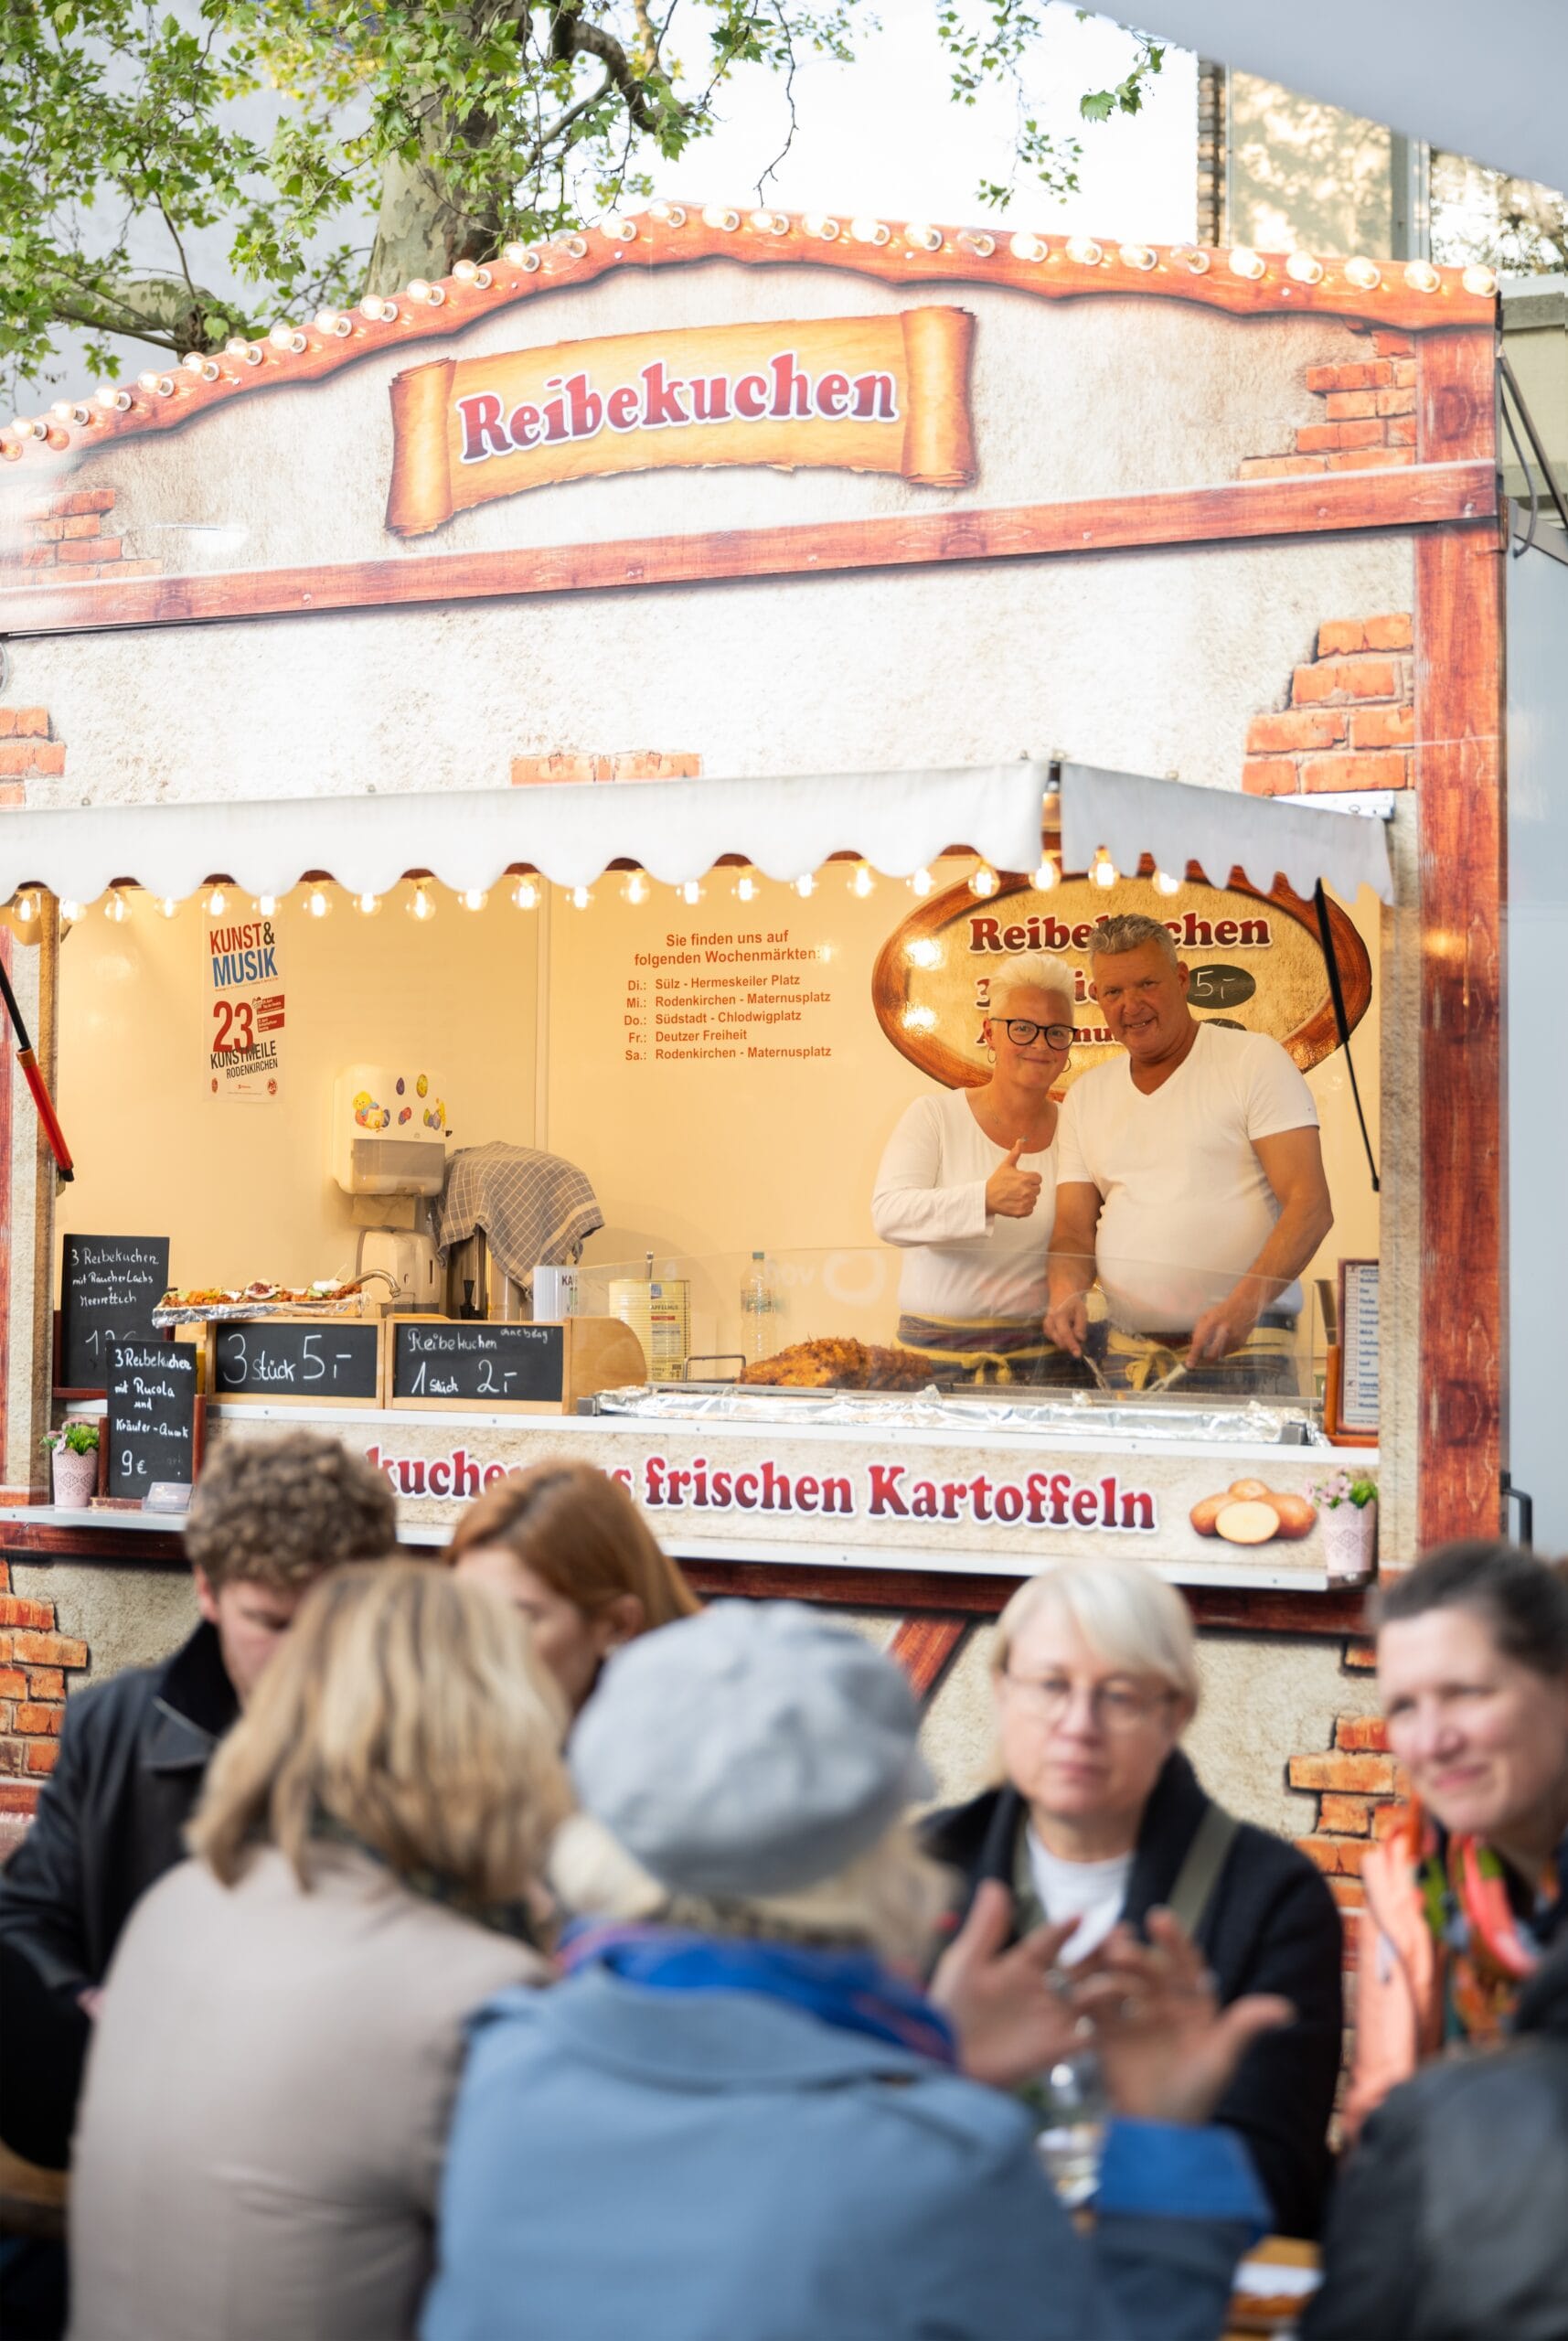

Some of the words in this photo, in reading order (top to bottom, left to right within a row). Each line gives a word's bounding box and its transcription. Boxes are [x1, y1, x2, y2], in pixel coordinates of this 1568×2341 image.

[458, 351, 899, 462] Reibekuchen
[666, 934, 687, 947] Sie
[691, 931, 732, 946] finden
[738, 932, 763, 944] uns
[767, 929, 789, 943] auf
[968, 912, 1271, 952] Reibechen
[212, 946, 278, 988] MUSIK
[635, 951, 700, 968] folgenden
[627, 979, 646, 991] Di.:
[656, 978, 680, 990] Sülz
[690, 975, 768, 989] Hermeskeiler
[772, 974, 800, 987] Platz
[626, 997, 646, 1009] Mi.:
[656, 994, 736, 1007] Rodenkirchen
[747, 991, 831, 1007] Maternusplatz
[212, 1000, 254, 1054] 23
[624, 1014, 646, 1026] Do.:
[656, 1011, 708, 1025] Südstadt
[718, 1010, 802, 1025] Chlodwigplatz
[628, 1032, 646, 1043] Fr.:
[656, 1031, 699, 1042] Deutzer
[703, 1029, 748, 1041] Freiheit
[210, 1040, 277, 1070] KUNSTMEILE
[624, 1049, 646, 1062] Sa.:
[656, 1047, 736, 1060] Rodenkirchen
[747, 1046, 832, 1061] Maternusplatz
[226, 1058, 279, 1080] RODENKIRCHEN
[70, 1248, 80, 1267] 3
[82, 1246, 160, 1266] Reibekuchen
[72, 1273, 87, 1286] mit
[408, 1328, 497, 1352] Reibekuchen
[223, 1332, 248, 1384] 3
[114, 1380, 129, 1395] mit
[133, 1377, 175, 1397] Rucola
[411, 1361, 426, 1395] 1
[133, 1398, 153, 1411] und
[365, 1445, 521, 1498] kuche
[645, 1455, 854, 1515] frischen
[868, 1464, 1156, 1530] Kartoffeln
